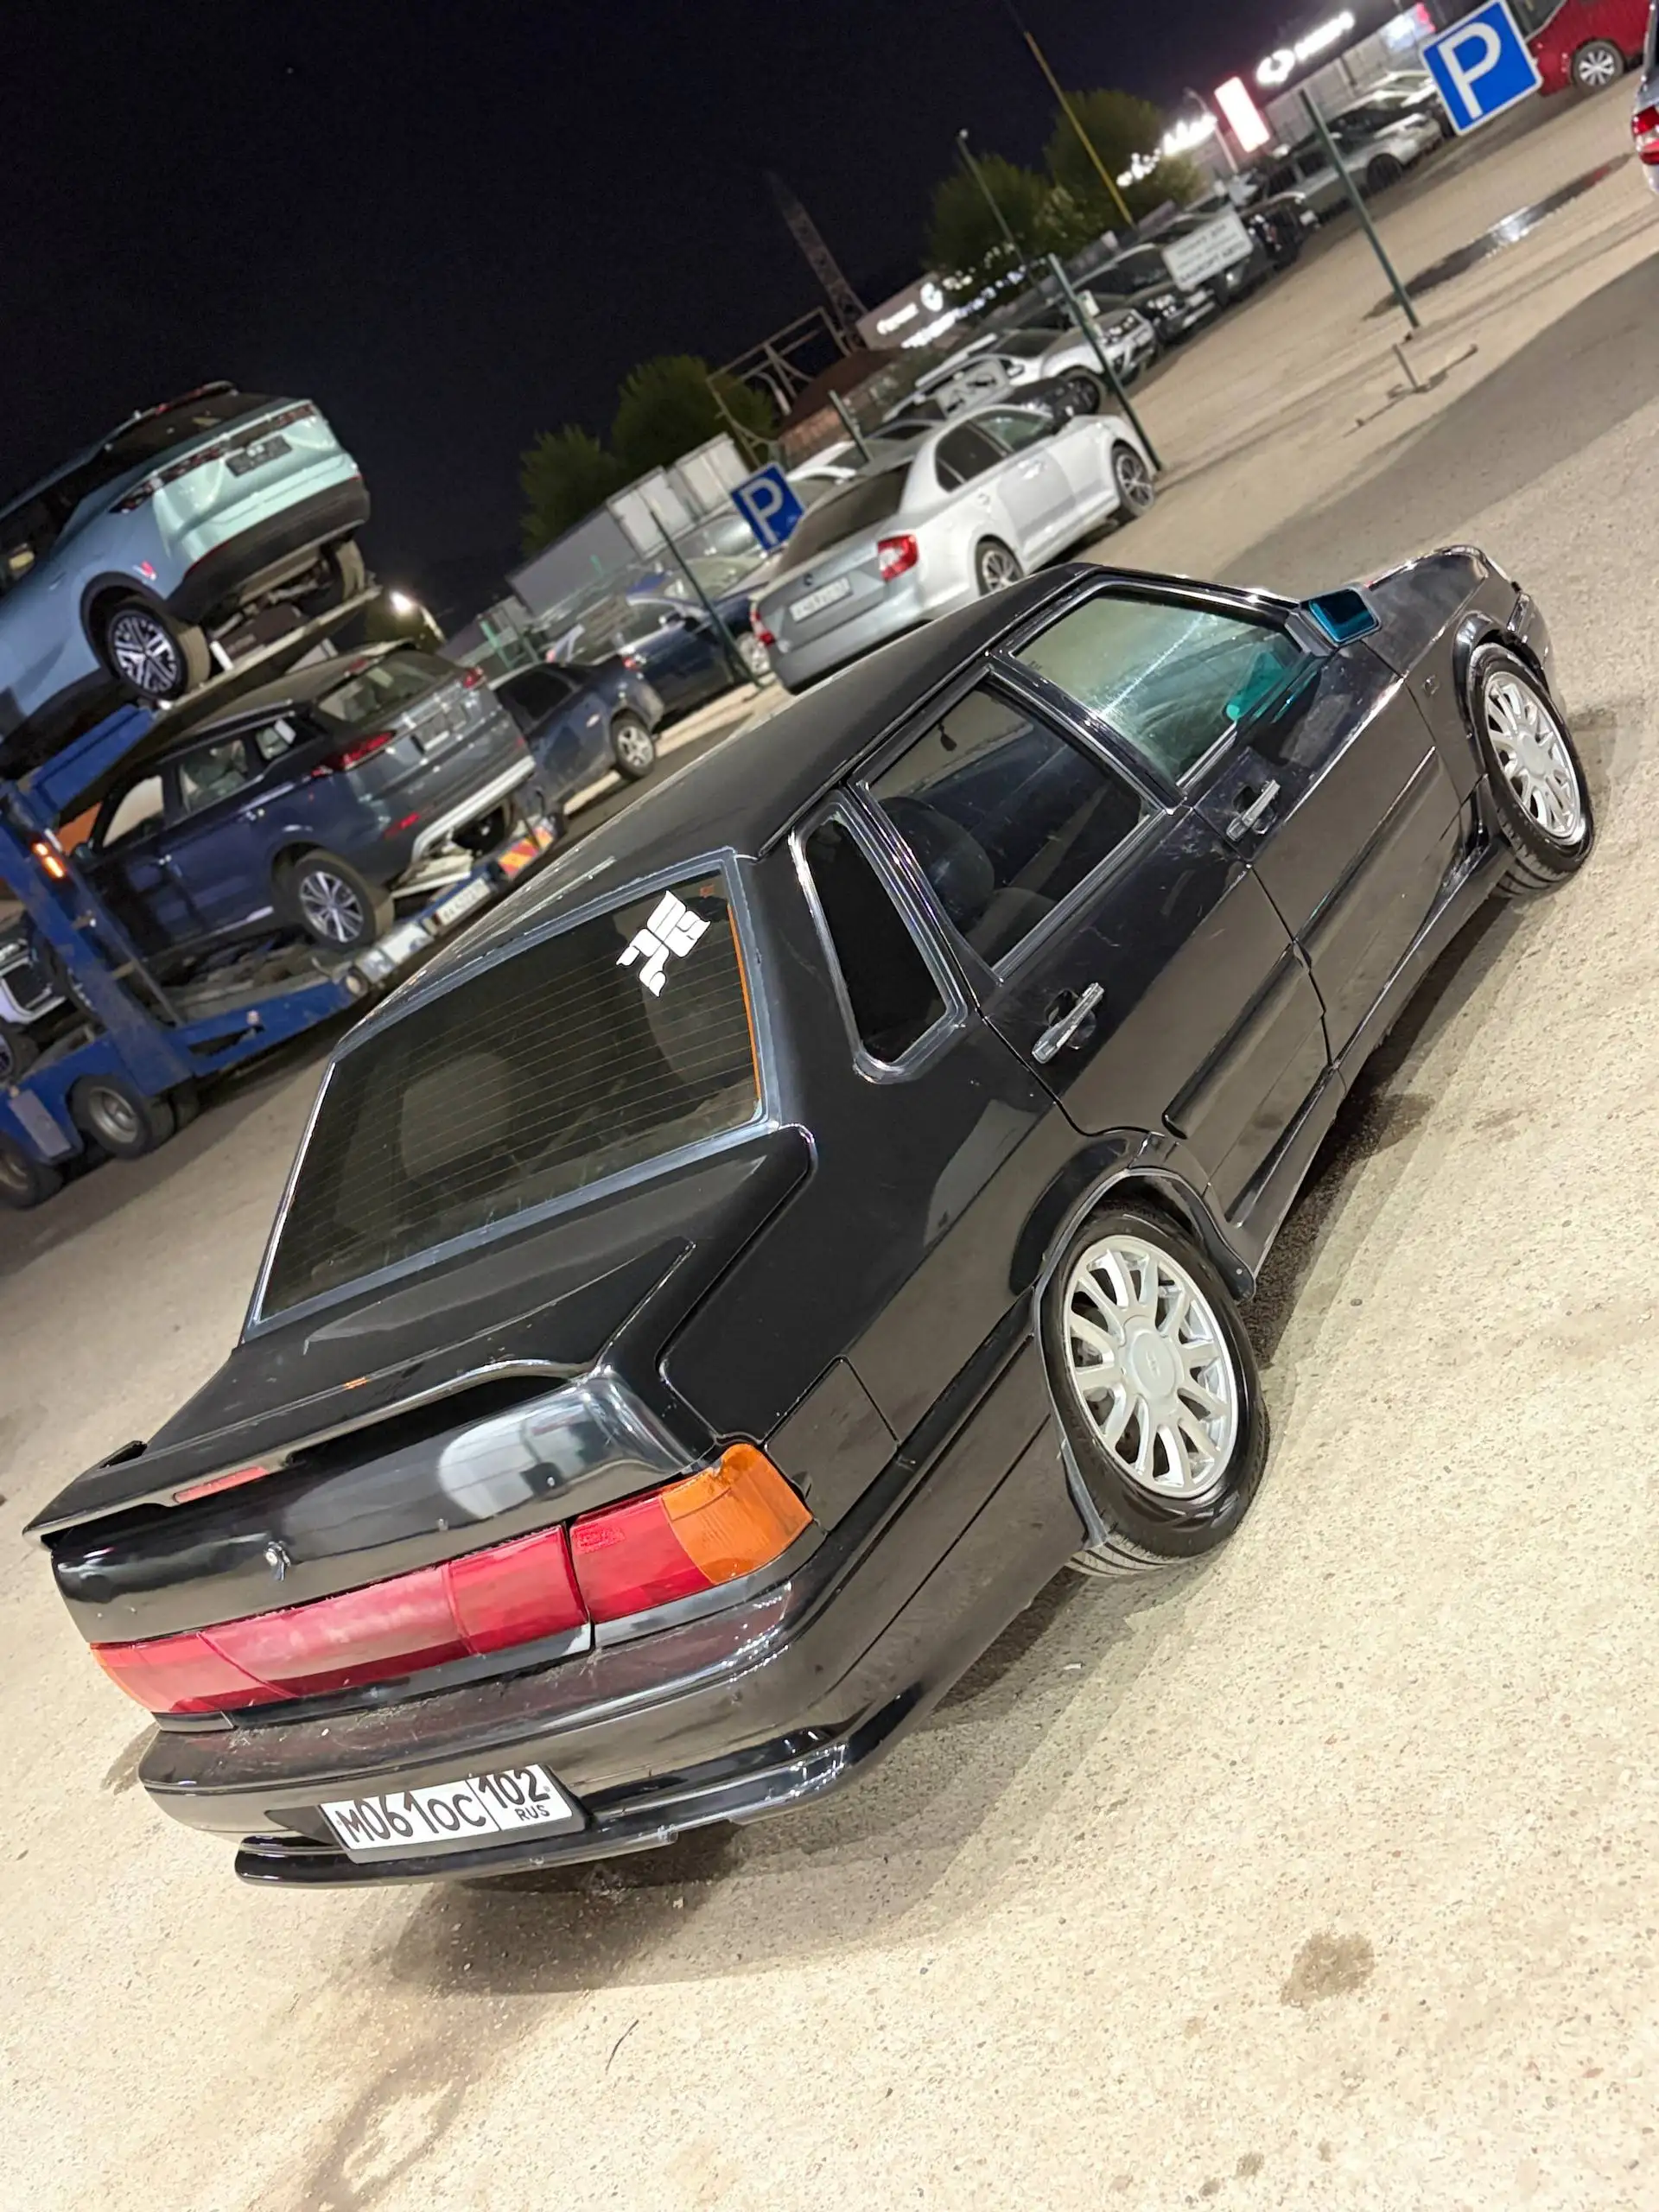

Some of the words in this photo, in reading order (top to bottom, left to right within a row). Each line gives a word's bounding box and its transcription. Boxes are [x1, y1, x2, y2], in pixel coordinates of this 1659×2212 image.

[1438, 22, 1501, 119] P
[741, 478, 783, 543] P
[479, 1770, 550, 1808] 102
[515, 1804, 550, 1821] RUS
